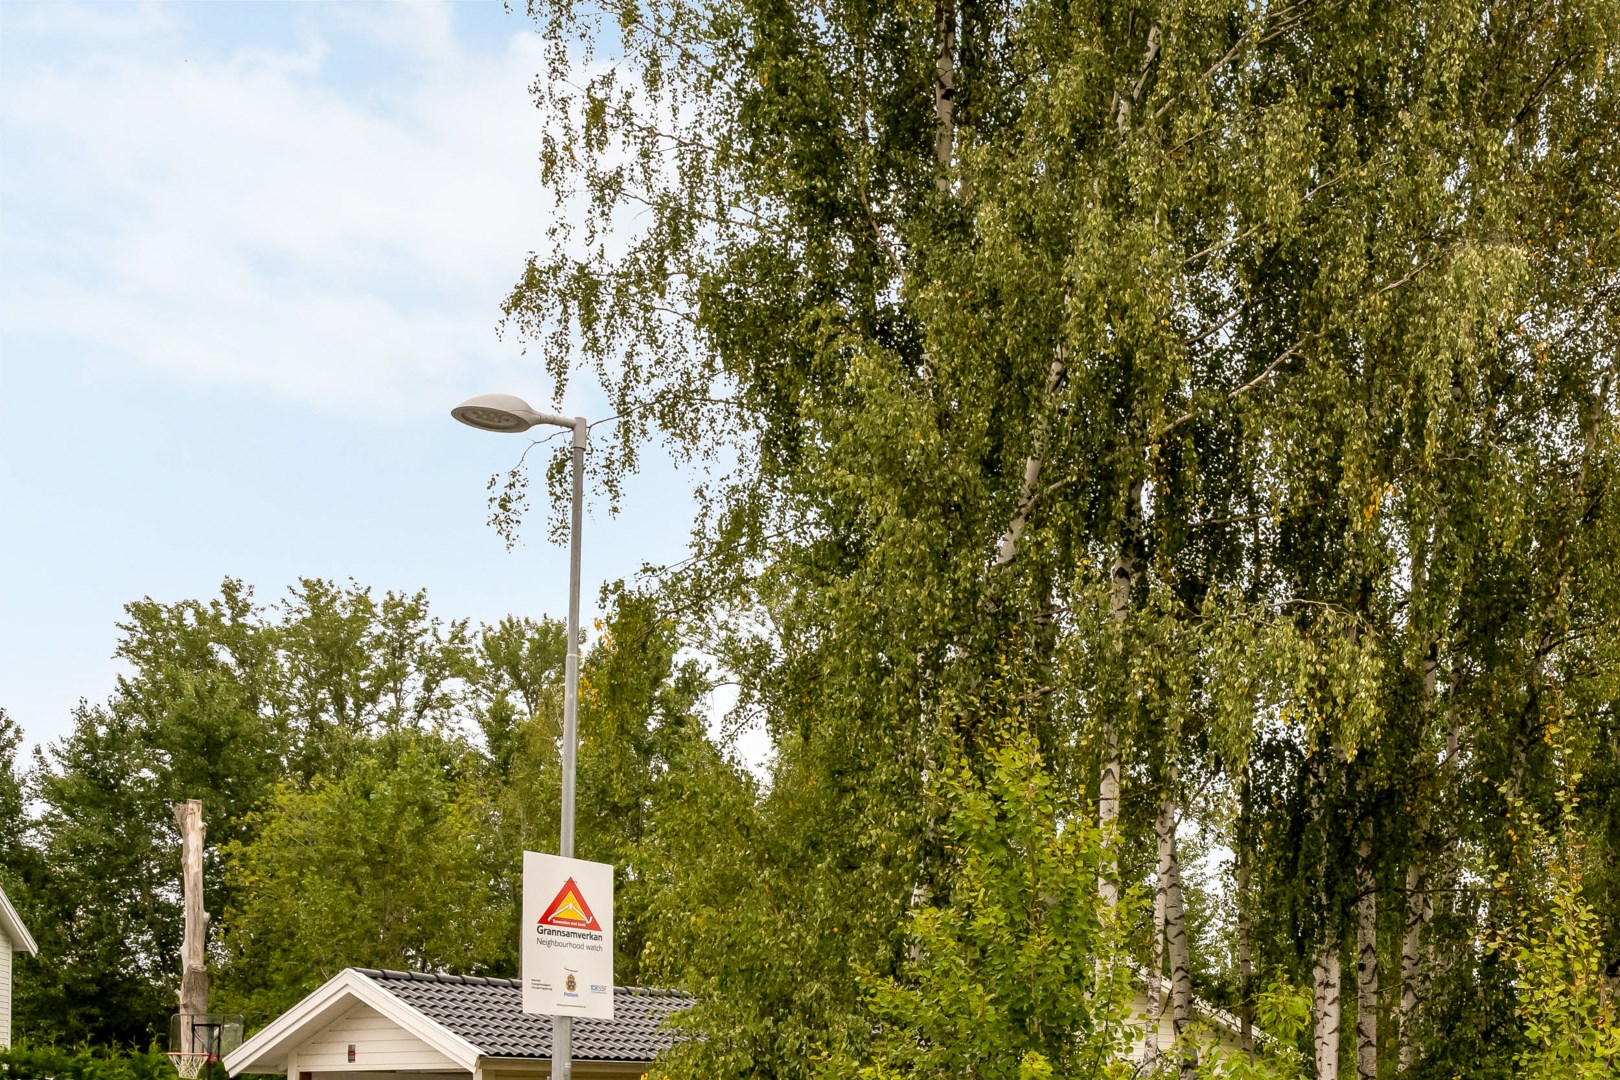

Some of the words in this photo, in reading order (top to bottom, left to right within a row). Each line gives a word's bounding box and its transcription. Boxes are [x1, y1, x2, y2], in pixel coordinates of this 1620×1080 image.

[536, 925, 603, 941] Grannsamverkan
[536, 937, 584, 950] Neighbourhood
[585, 943, 603, 952] watch
